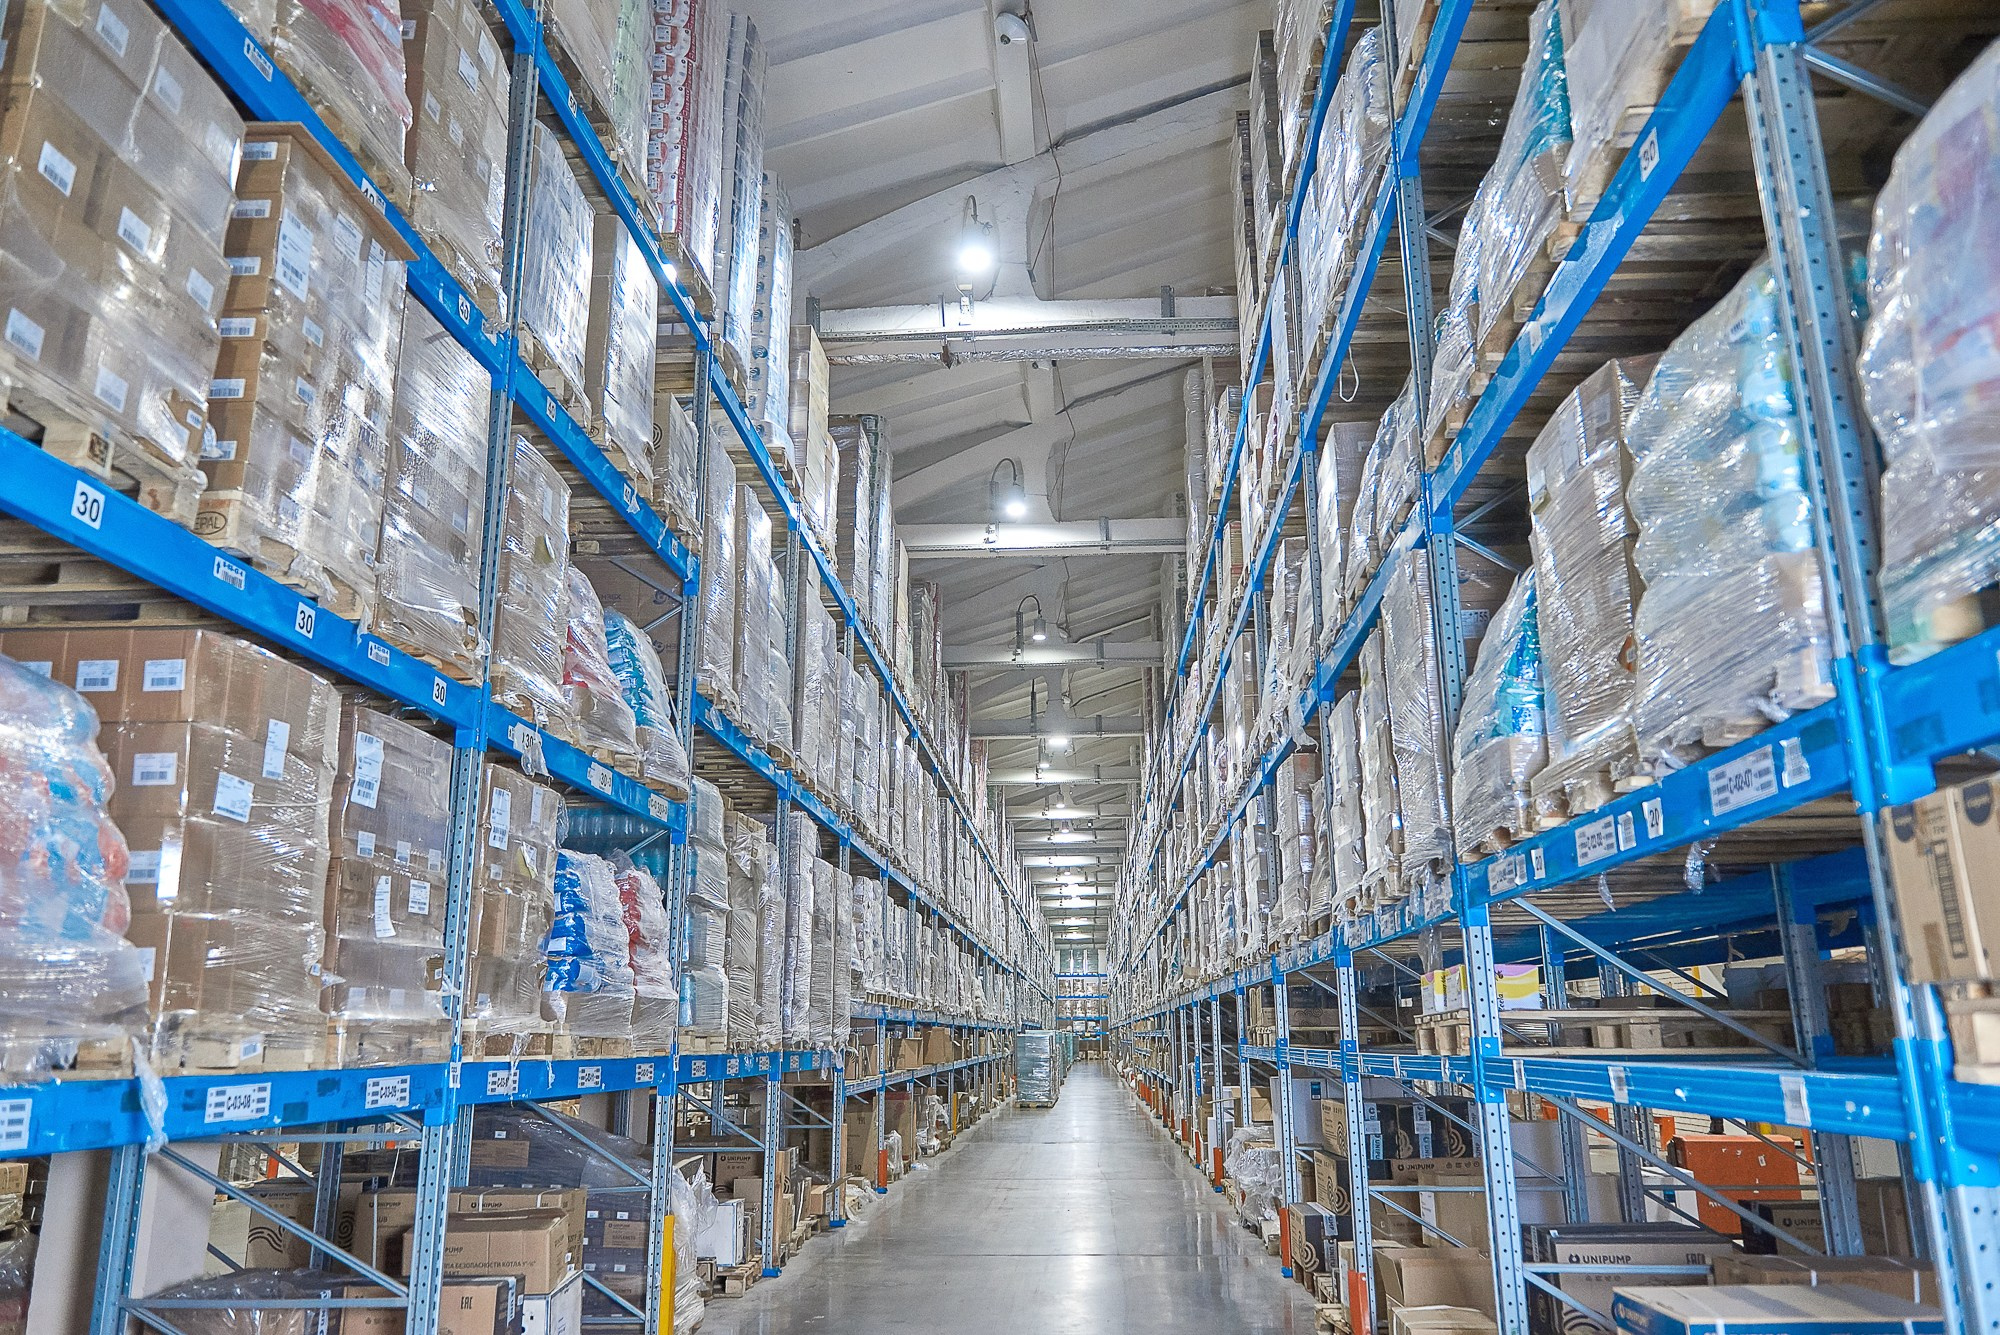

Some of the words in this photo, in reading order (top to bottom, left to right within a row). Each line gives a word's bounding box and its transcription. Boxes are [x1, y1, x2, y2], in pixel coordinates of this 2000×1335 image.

[1643, 140, 1655, 170] 30
[460, 301, 469, 320] 40
[77, 491, 100, 523] 30
[195, 516, 221, 531] EPAL
[298, 610, 313, 634] 30
[434, 683, 445, 703] 30
[1649, 808, 1660, 828] 20
[226, 1095, 251, 1111] C-03-08
[1582, 1255, 1631, 1264] UNIPUMP
